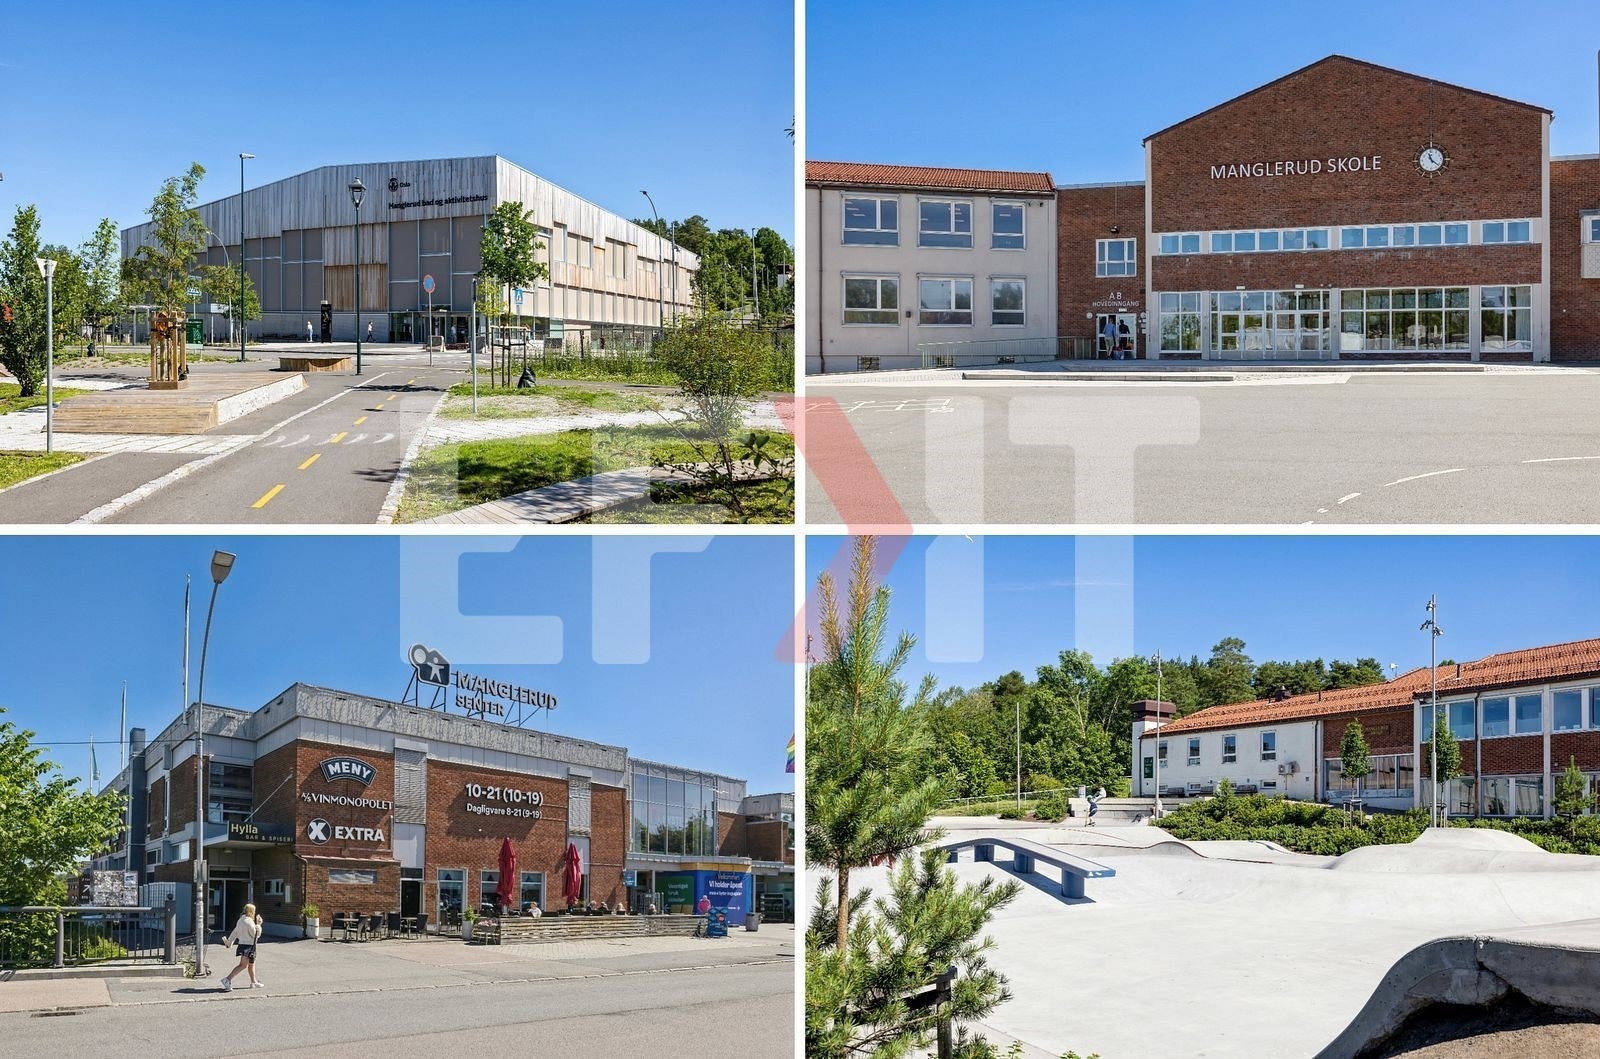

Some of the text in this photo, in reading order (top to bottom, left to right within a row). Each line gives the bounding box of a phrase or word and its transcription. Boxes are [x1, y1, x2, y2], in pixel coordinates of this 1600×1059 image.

[1210, 155, 1382, 179] MANGLERUD SKOLE
[388, 200, 420, 209] Manglerud
[445, 194, 488, 204] aktivitetshus
[456, 671, 558, 710] MANGLERUD
[455, 694, 504, 717] SENTER
[327, 761, 372, 779] MENY
[311, 793, 393, 810] VINMONOPOLET
[466, 783, 544, 807] 10-21 (10-19)
[466, 803, 543, 819] Dagligvare 8-21 (9-19)
[231, 823, 258, 835] Hylla
[334, 825, 385, 842] EXTRA
